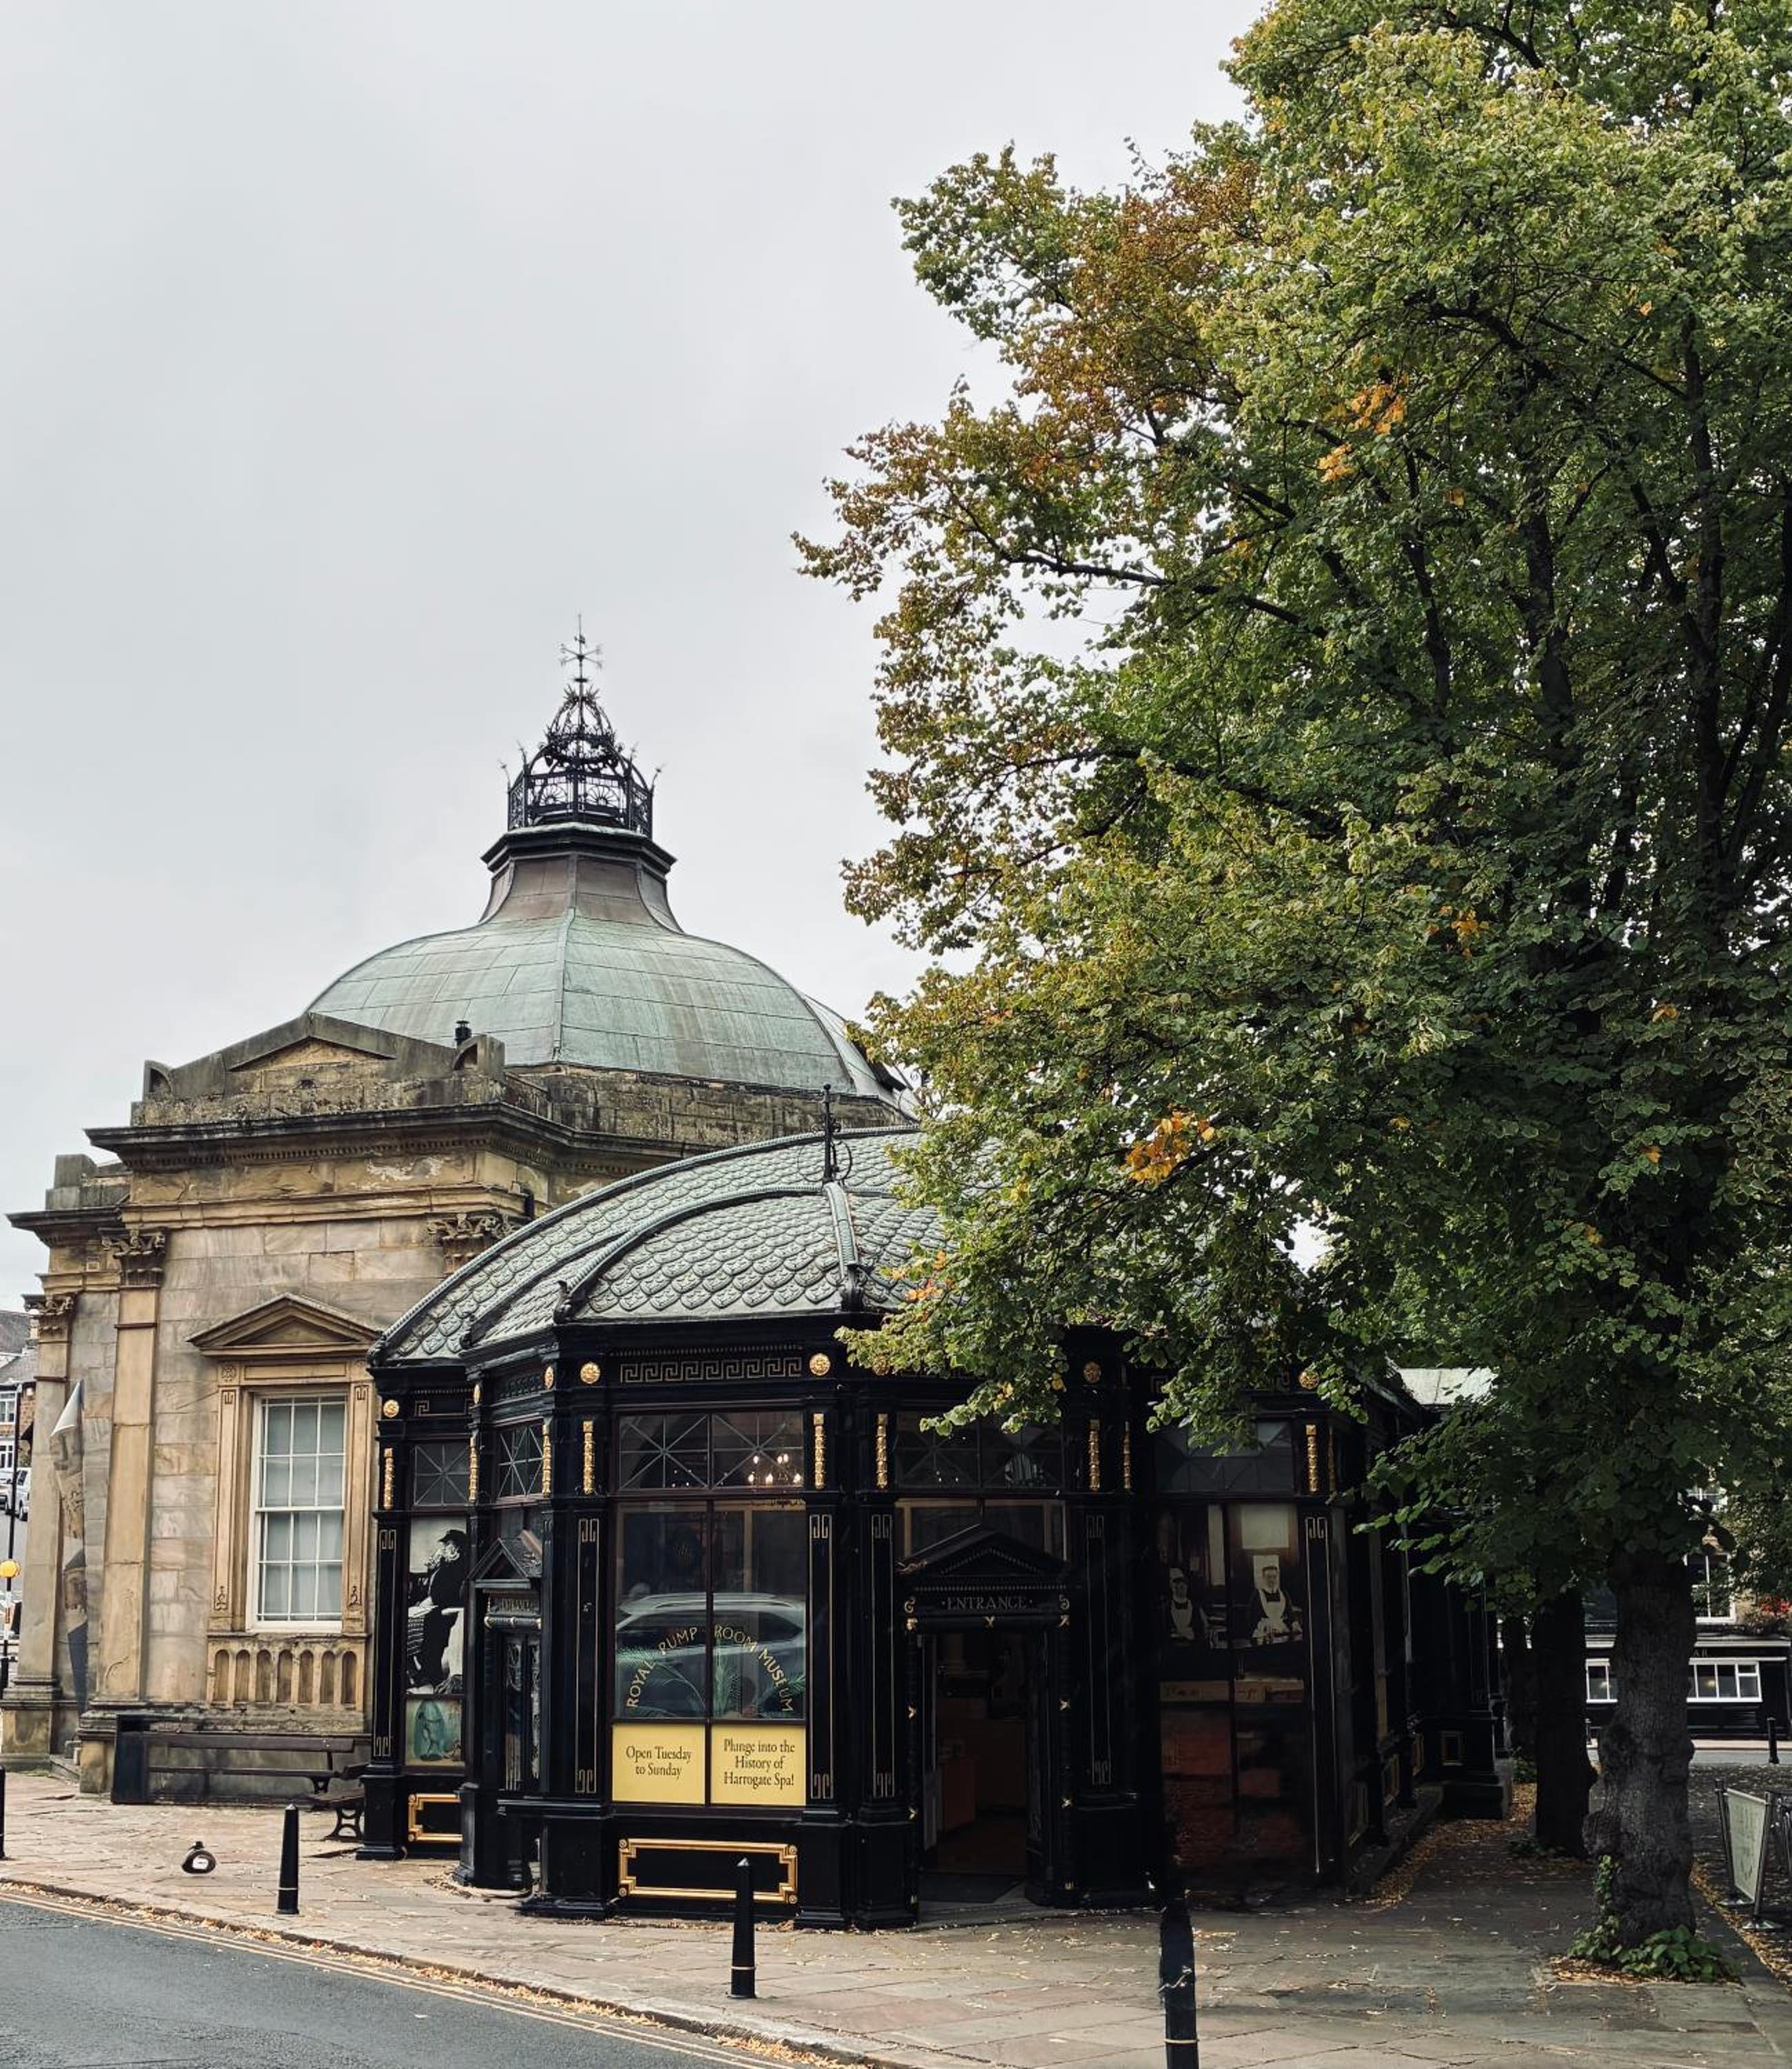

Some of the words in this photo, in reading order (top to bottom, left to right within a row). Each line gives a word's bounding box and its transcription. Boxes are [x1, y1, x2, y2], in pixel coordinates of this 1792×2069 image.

[947, 1596, 1026, 1611] ENTRANCE
[626, 1660, 656, 1708] ROYAL
[659, 1627, 697, 1655] PUMP
[714, 1624, 757, 1652] ROOM
[758, 1648, 794, 1711] MUSEUM
[626, 1745, 652, 1763] Open
[654, 1746, 691, 1764] Tuesday
[724, 1737, 755, 1756] Plunge
[757, 1739, 777, 1752] into
[779, 1739, 795, 1752] the
[635, 1766, 646, 1775] to
[648, 1762, 682, 1780] Sunday
[735, 1755, 772, 1772] History
[773, 1755, 786, 1769] of
[724, 1771, 772, 1790] Harrogate
[774, 1772, 794, 1790] Spa!
